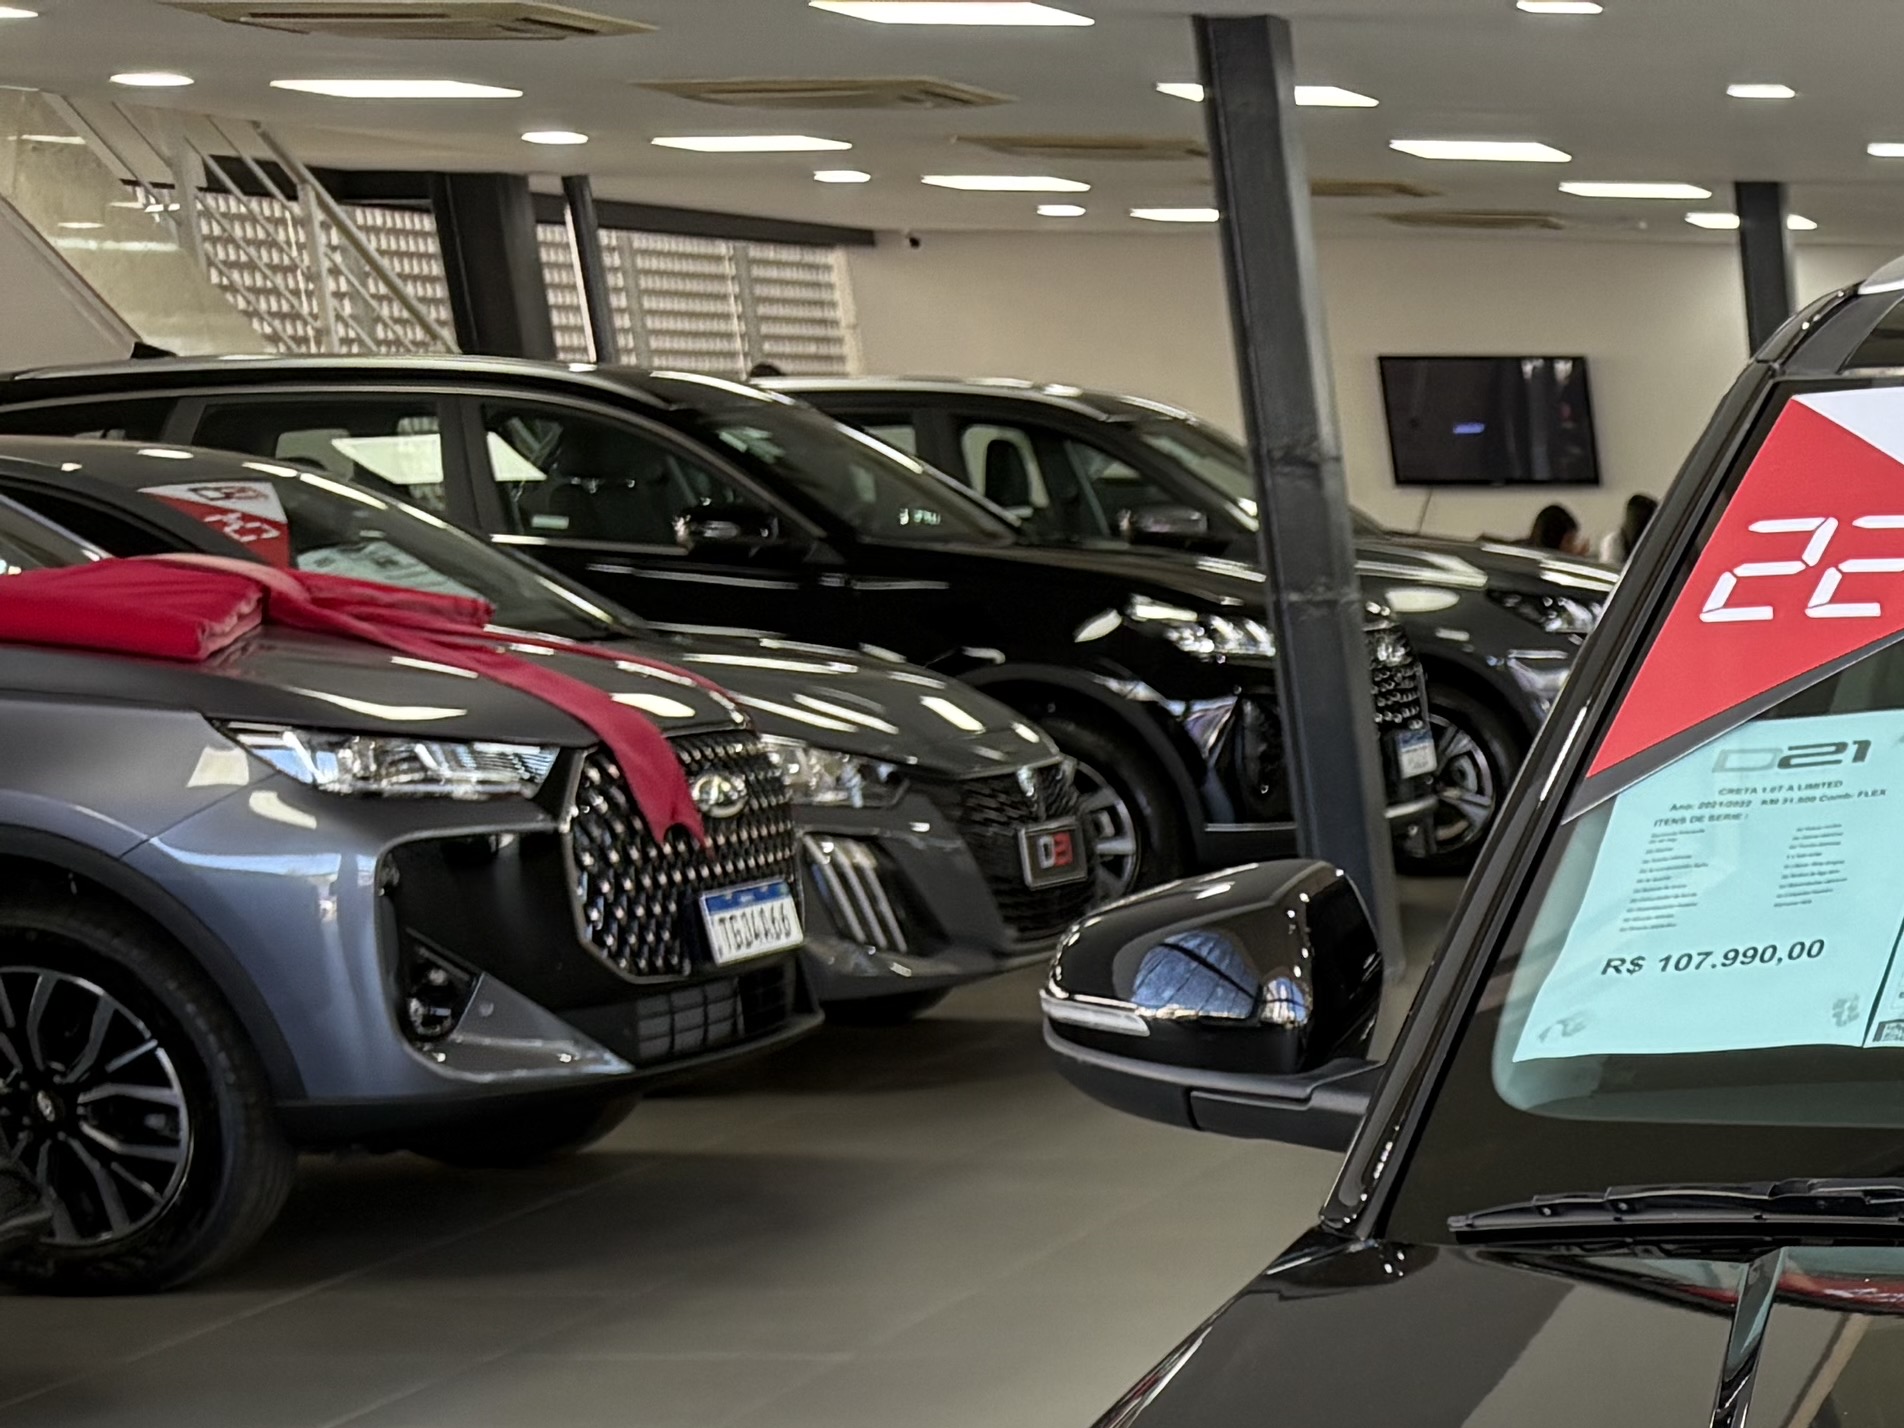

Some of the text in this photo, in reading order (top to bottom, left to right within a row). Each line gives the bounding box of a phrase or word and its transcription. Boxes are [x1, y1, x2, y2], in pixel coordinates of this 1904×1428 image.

[1711, 739, 1873, 774] D21
[1717, 785, 1758, 797] CRETA
[1600, 938, 1826, 977] R$ 107.990,00
